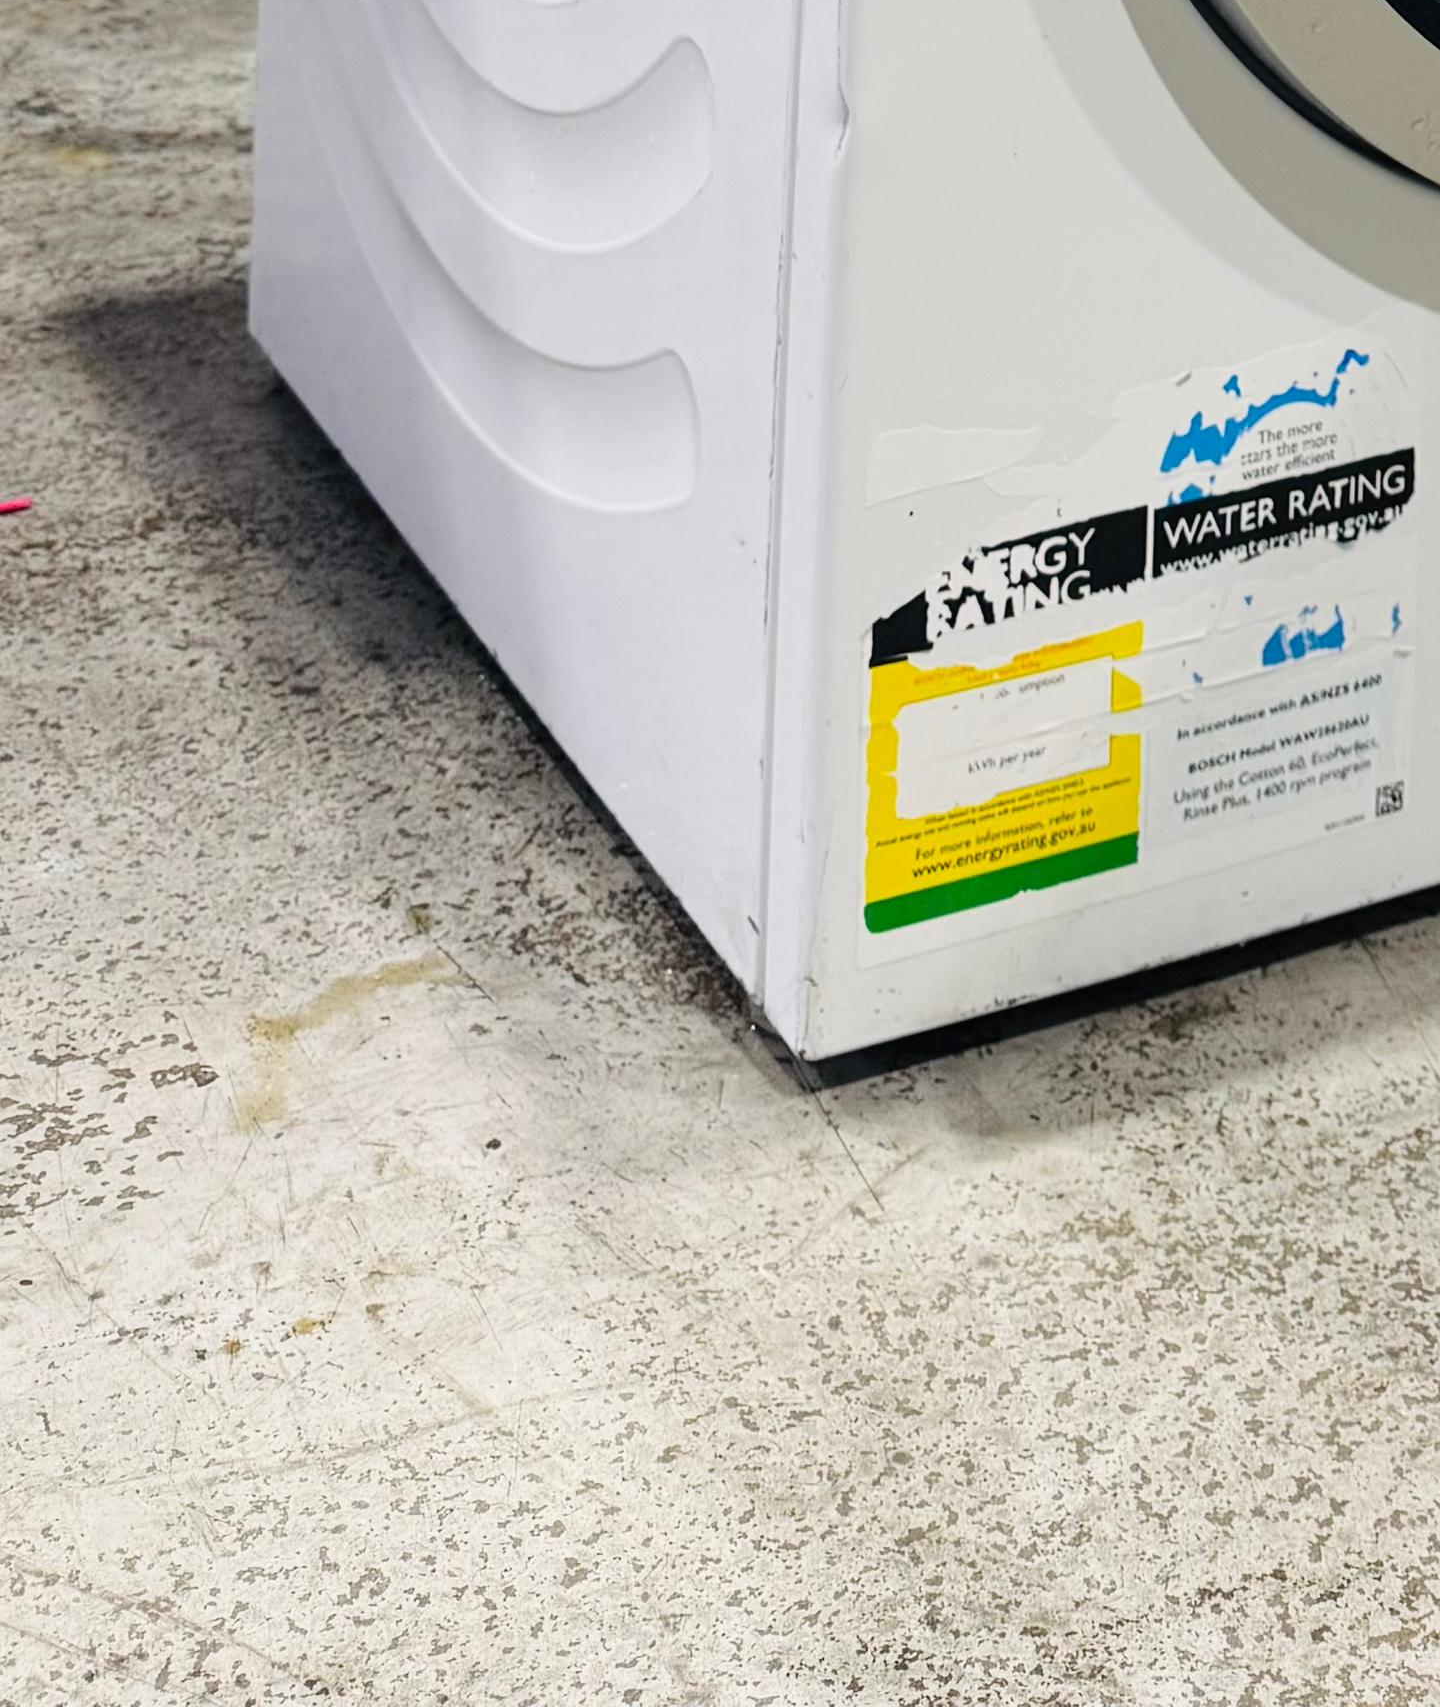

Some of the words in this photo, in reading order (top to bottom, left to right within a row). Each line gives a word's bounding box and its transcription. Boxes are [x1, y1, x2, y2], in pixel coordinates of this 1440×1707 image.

[1258, 429, 1284, 445] The
[1287, 420, 1325, 439] more
[1276, 440, 1299, 458] the
[1302, 431, 1339, 451] more
[1242, 462, 1281, 481] water
[1284, 449, 1337, 472] efficient
[1163, 496, 1278, 549] WATER
[1288, 464, 1407, 521] RATING
[1177, 727, 1191, 742] In
[1193, 708, 1266, 737] accordance
[1269, 698, 1297, 716] with
[998, 751, 1018, 770] per
[1021, 745, 1048, 765] year
[1187, 749, 1237, 775] BOSCH
[1239, 739, 1276, 761] Model
[1173, 786, 1210, 805] Using
[1213, 776, 1234, 793] the
[1238, 762, 1285, 787] Cotton
[1182, 800, 1218, 822] Rinse
[1255, 780, 1288, 802] 1400
[1288, 775, 1317, 793] rpm
[1318, 758, 1372, 784] program
[912, 821, 1097, 878] www.energyrating.gov.au
[915, 845, 935, 861] For
[939, 838, 971, 856] more
[975, 820, 1043, 845] information,
[1048, 809, 1078, 828] refer
[1080, 805, 1094, 818] to
